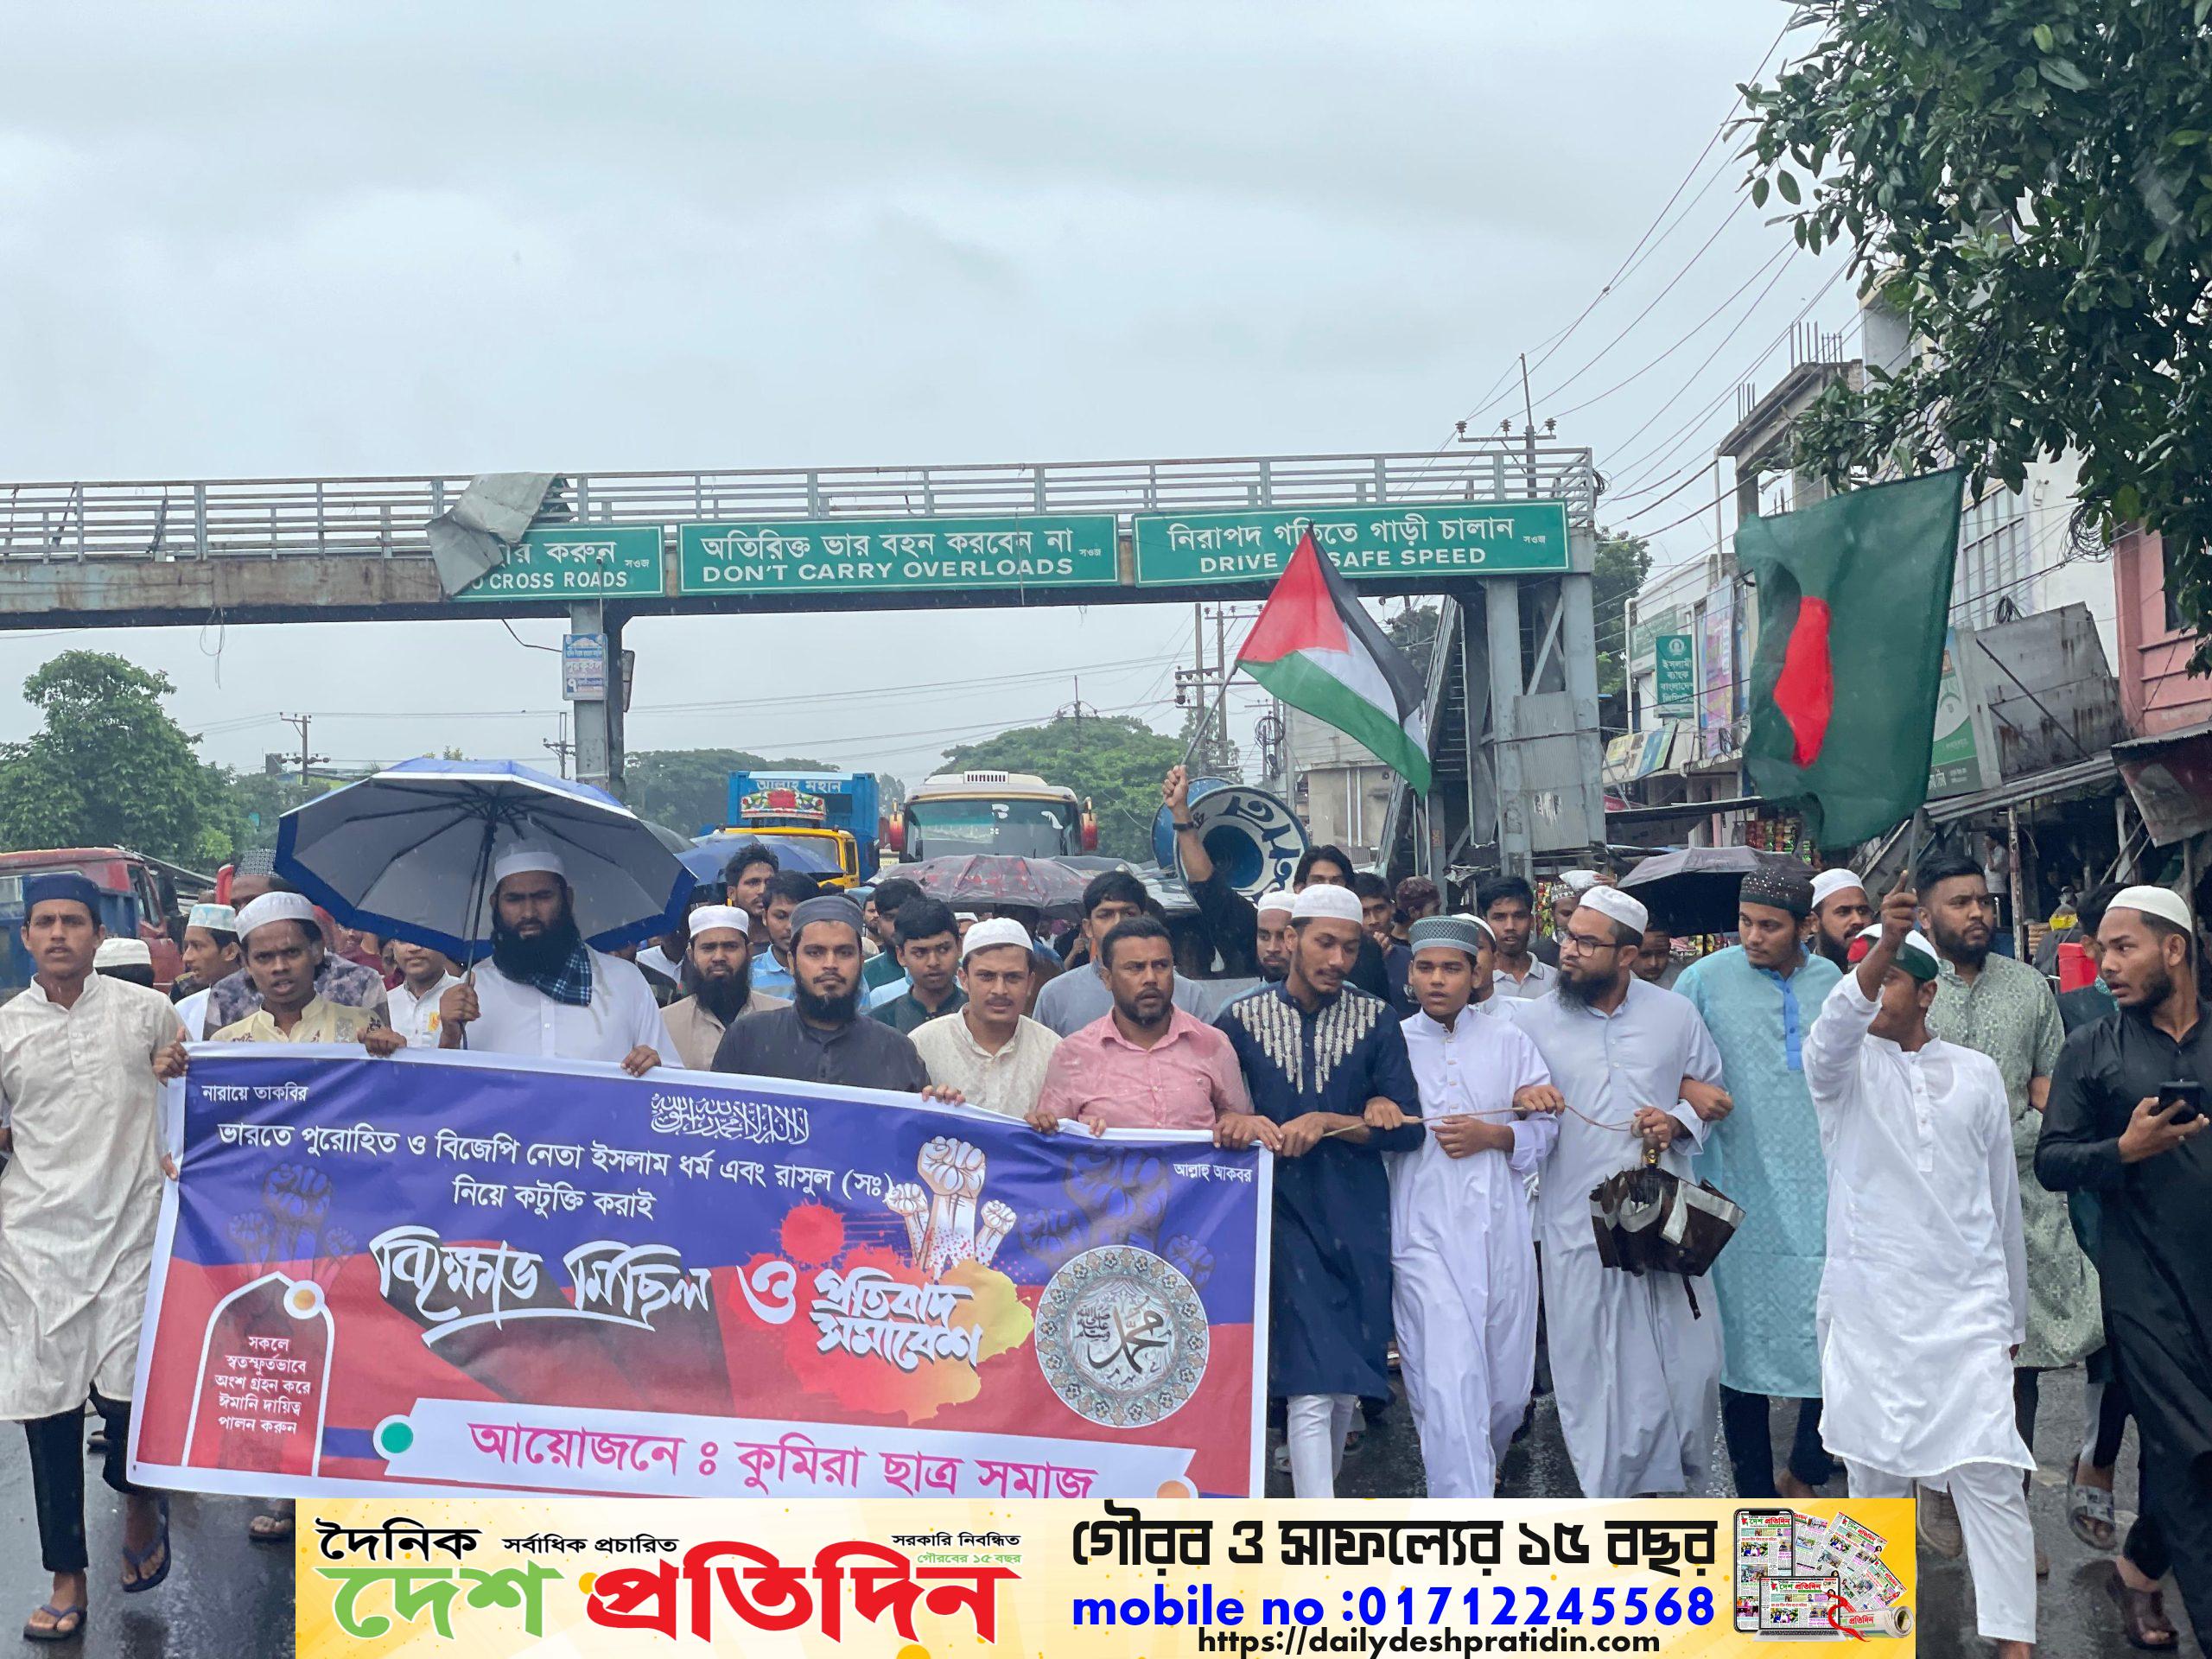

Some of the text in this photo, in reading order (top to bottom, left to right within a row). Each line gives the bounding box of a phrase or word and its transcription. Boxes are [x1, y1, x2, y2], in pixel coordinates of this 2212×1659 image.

[700, 527, 1074, 561] অতিরিক্ত ভার বহন করবেন না
[1166, 523, 1262, 551] নিরাপদ
[1370, 512, 1429, 547] গাড়ী
[1438, 516, 1515, 541] চালান
[499, 541, 617, 568] ার করুন
[1200, 552, 1278, 573] DRIVE
[1327, 550, 1391, 567] SAFE
[1400, 547, 1486, 565] SPEED
[489, 572, 554, 589] CROSS
[563, 571, 627, 588] ROADS
[702, 558, 1073, 582] DON'T CARRY OVERLOADS
[201, 1082, 309, 1103] নারায়ে তাকবির
[218, 1122, 295, 1147] ভারতে
[302, 1122, 400, 1157] পুরোহিত
[407, 1135, 426, 1155] ও
[435, 1128, 521, 1164] বিজেপি
[527, 1143, 585, 1170] নেতা
[590, 1141, 672, 1176] ইসলাম
[679, 1149, 715, 1180] ধর্ম
[720, 1161, 766, 1188] এবং
[774, 1164, 836, 1198] রাসুল
[1212, 1165, 1252, 1183] আকবর
[452, 1173, 658, 1221] নিয়ে কটুক্তি করাই
[369, 1225, 797, 1332] বিক্ষোভ মিছিল ও
[811, 1267, 974, 1325] প্রতিবাদ
[249, 1336, 289, 1351] সকলে
[810, 1313, 983, 1371] সমাবেশ
[215, 1375, 311, 1395] অংশ গ্রহন করে
[219, 1392, 259, 1411] ঈমানি
[218, 1416, 297, 1434] পালন করুন
[467, 1421, 688, 1476] আয়োজনে
[734, 1432, 868, 1496] কুমিরা
[878, 1451, 965, 1497] ছাত্র
[974, 1460, 1098, 1498] সমাজ
